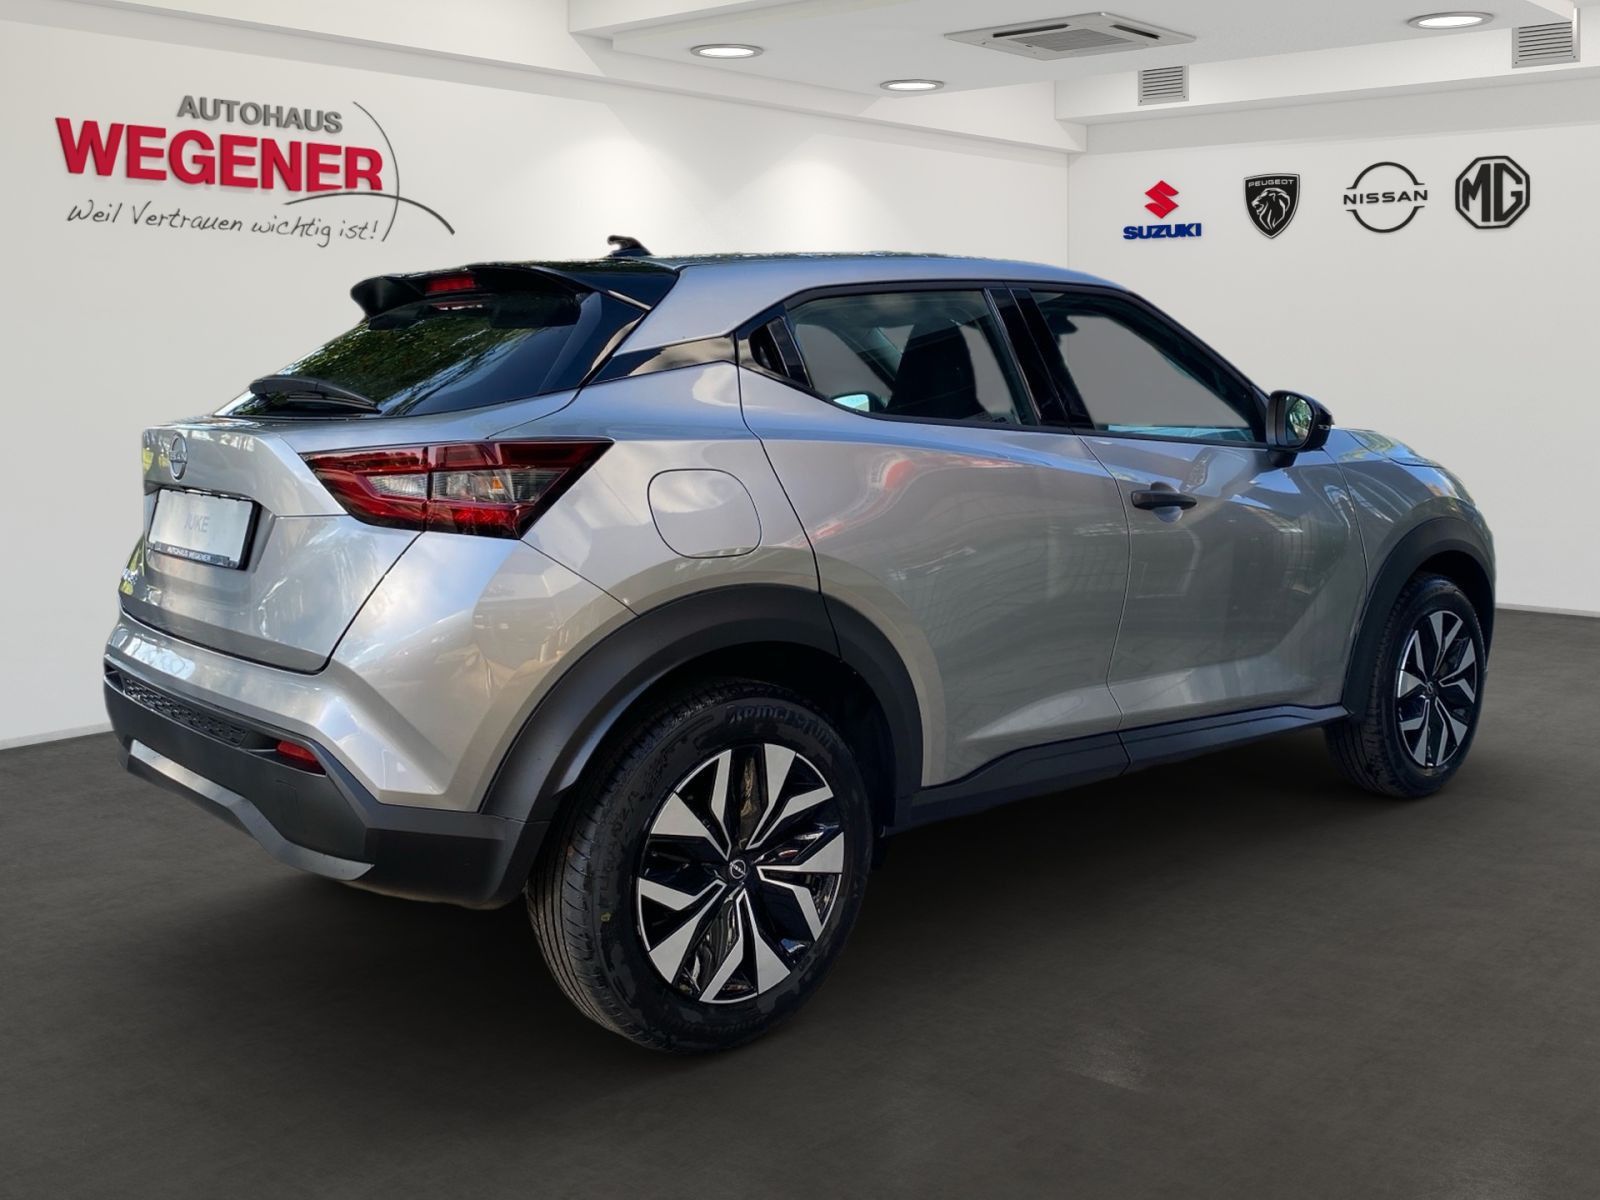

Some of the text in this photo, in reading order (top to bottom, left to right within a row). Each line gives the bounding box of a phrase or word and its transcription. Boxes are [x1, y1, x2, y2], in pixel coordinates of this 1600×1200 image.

[177, 95, 343, 133] AUTOHAUS
[55, 117, 383, 192] WEGENER
[1248, 178, 1295, 188] PEUGEOT
[1343, 189, 1428, 206] NISSAN
[1462, 162, 1523, 223] MG
[67, 199, 378, 247] Weil Vertrauen wichtig ist!
[1123, 222, 1202, 240] SUZUKI
